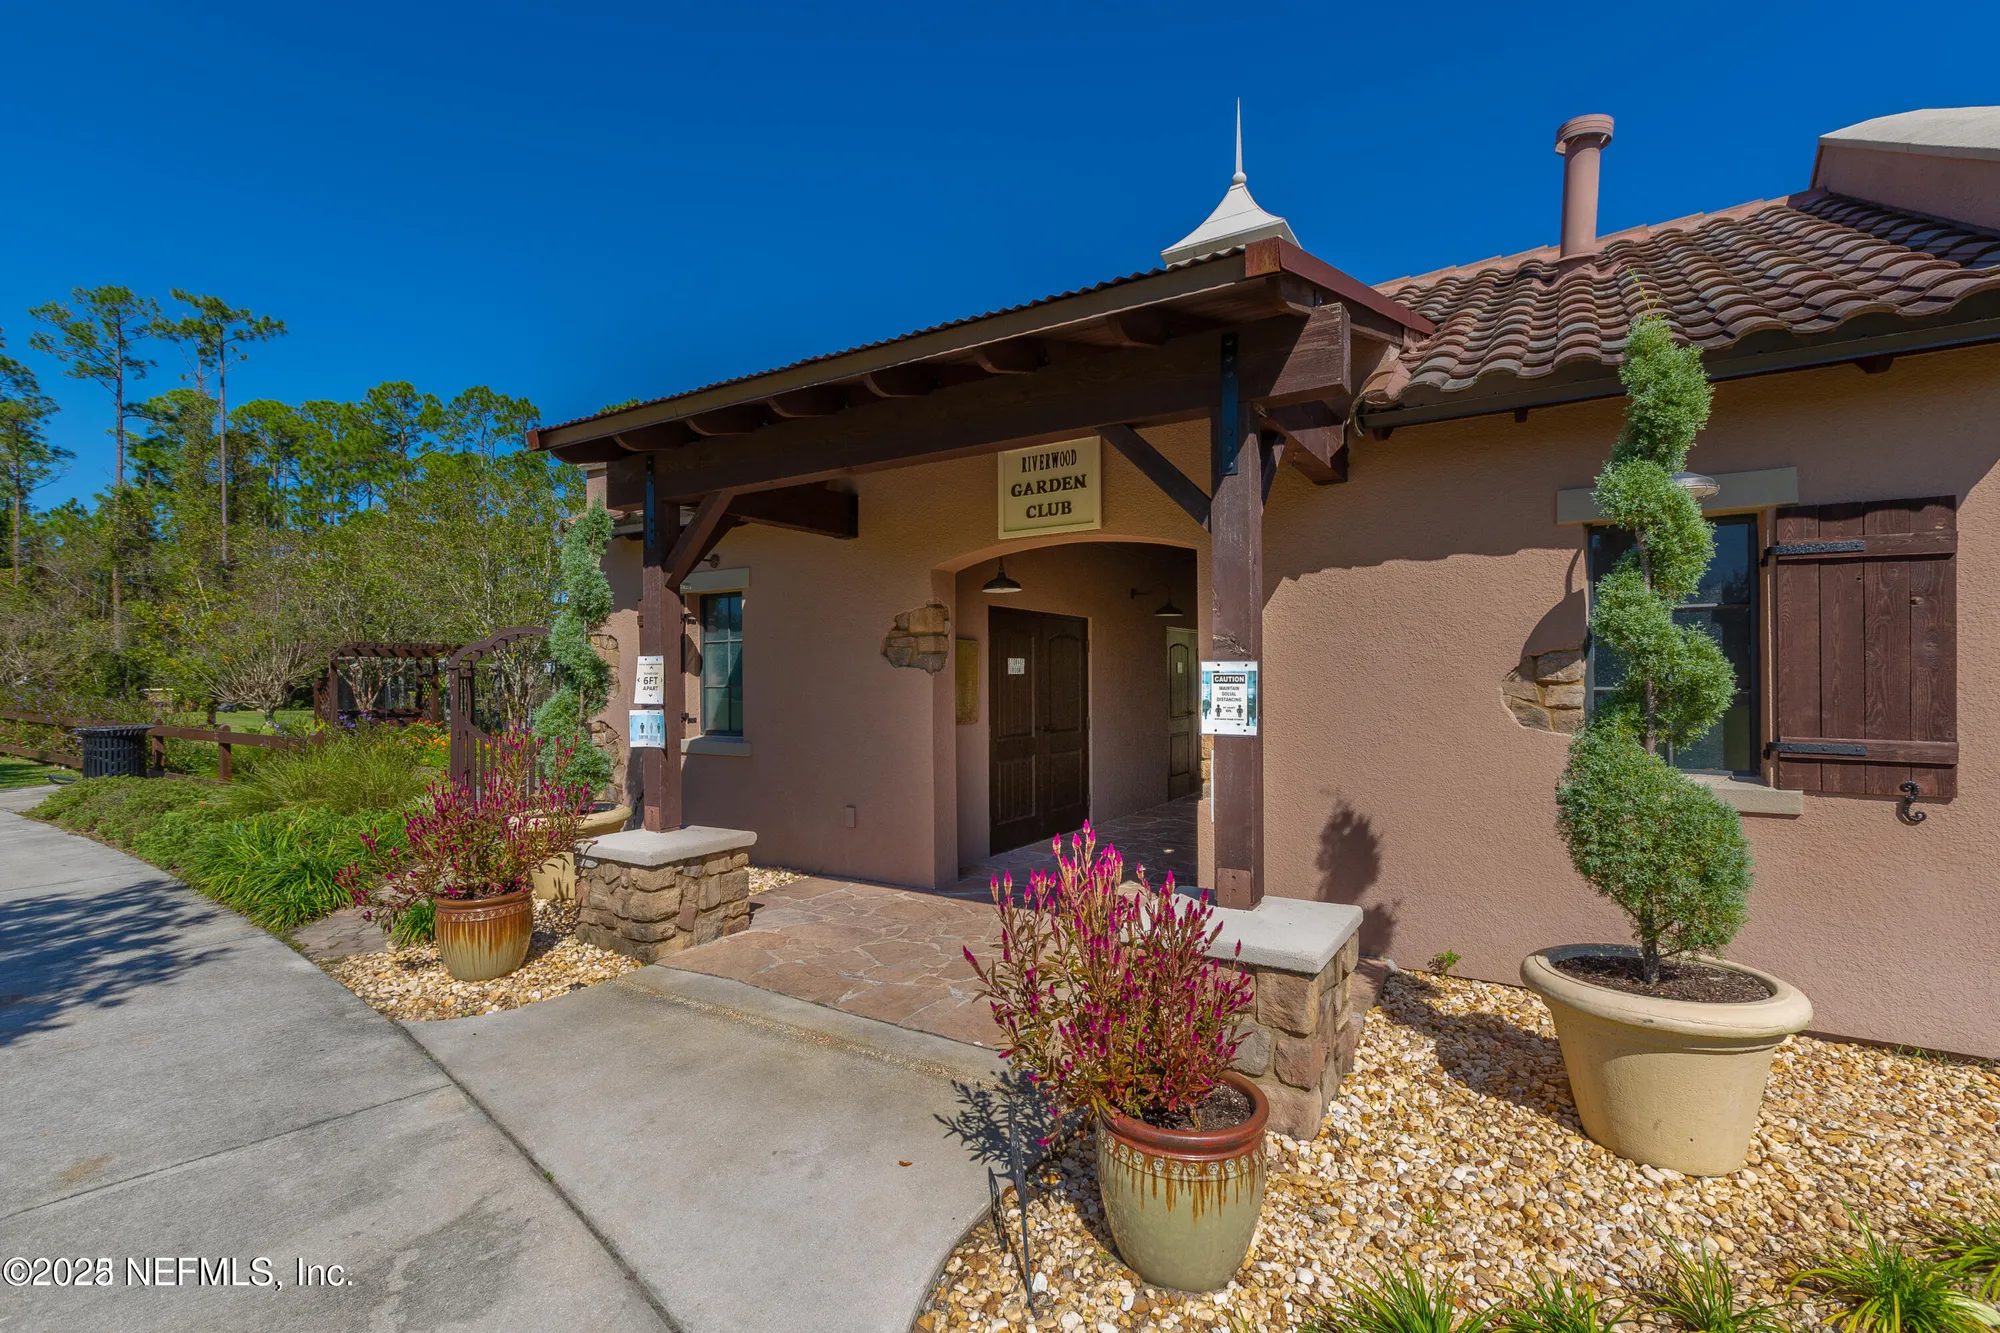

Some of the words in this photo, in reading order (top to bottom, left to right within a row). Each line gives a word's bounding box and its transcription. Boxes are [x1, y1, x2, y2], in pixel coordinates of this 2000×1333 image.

[1021, 449, 1077, 473] RIVERWOOD
[1010, 474, 1087, 497] GARDEN
[1026, 501, 1072, 519] CLUB
[643, 676, 658, 685] 6FT
